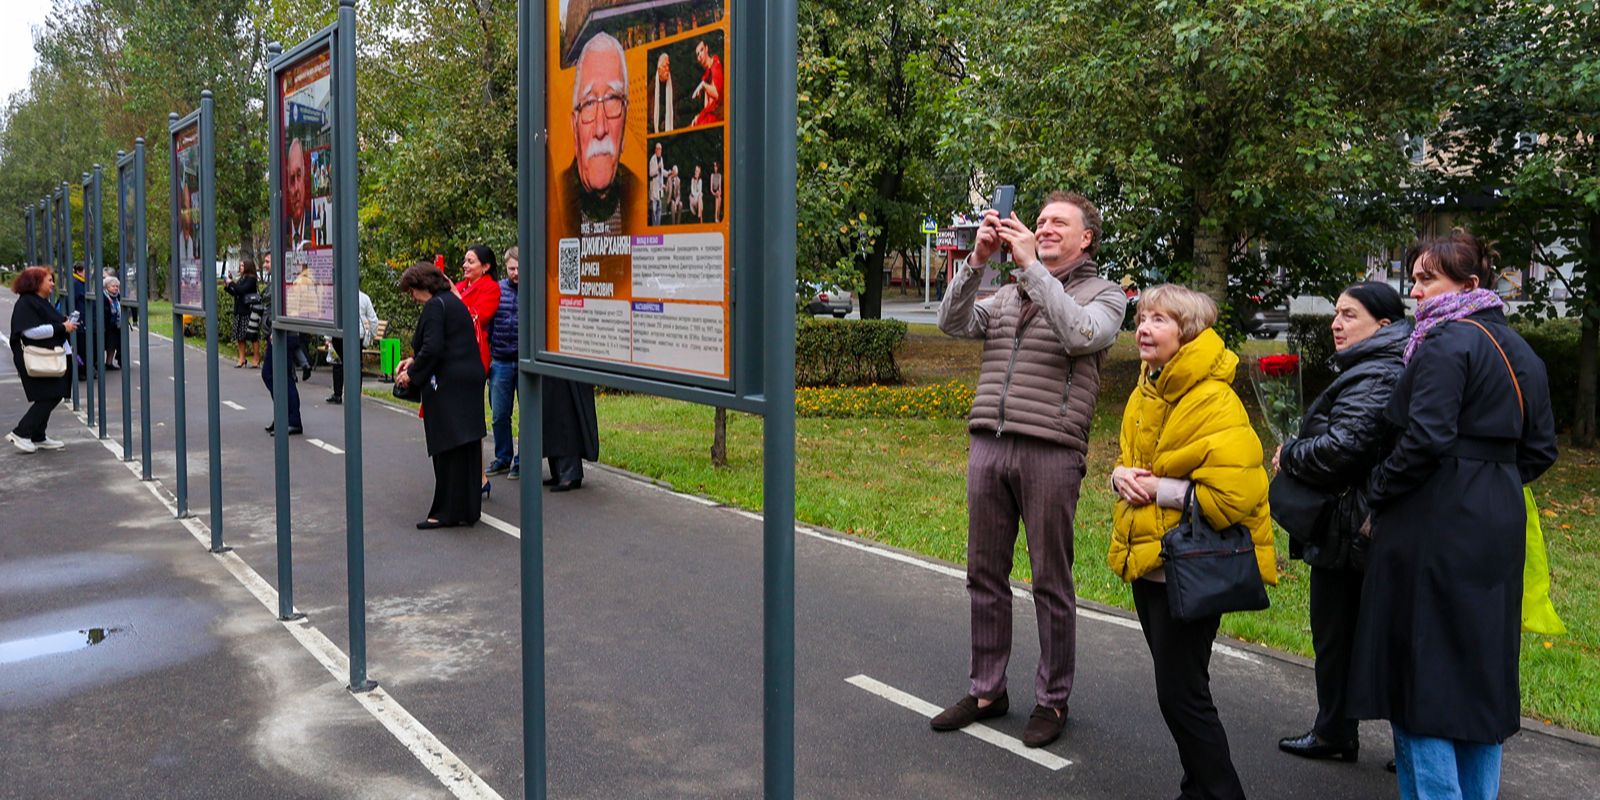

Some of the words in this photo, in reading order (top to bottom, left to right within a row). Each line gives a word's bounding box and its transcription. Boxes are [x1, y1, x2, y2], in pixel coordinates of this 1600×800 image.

[580, 235, 631, 258] ДЖИГАРХАНЯН
[580, 262, 600, 276] АРМЕН
[580, 282, 614, 297] БОРИСОВИЧ
